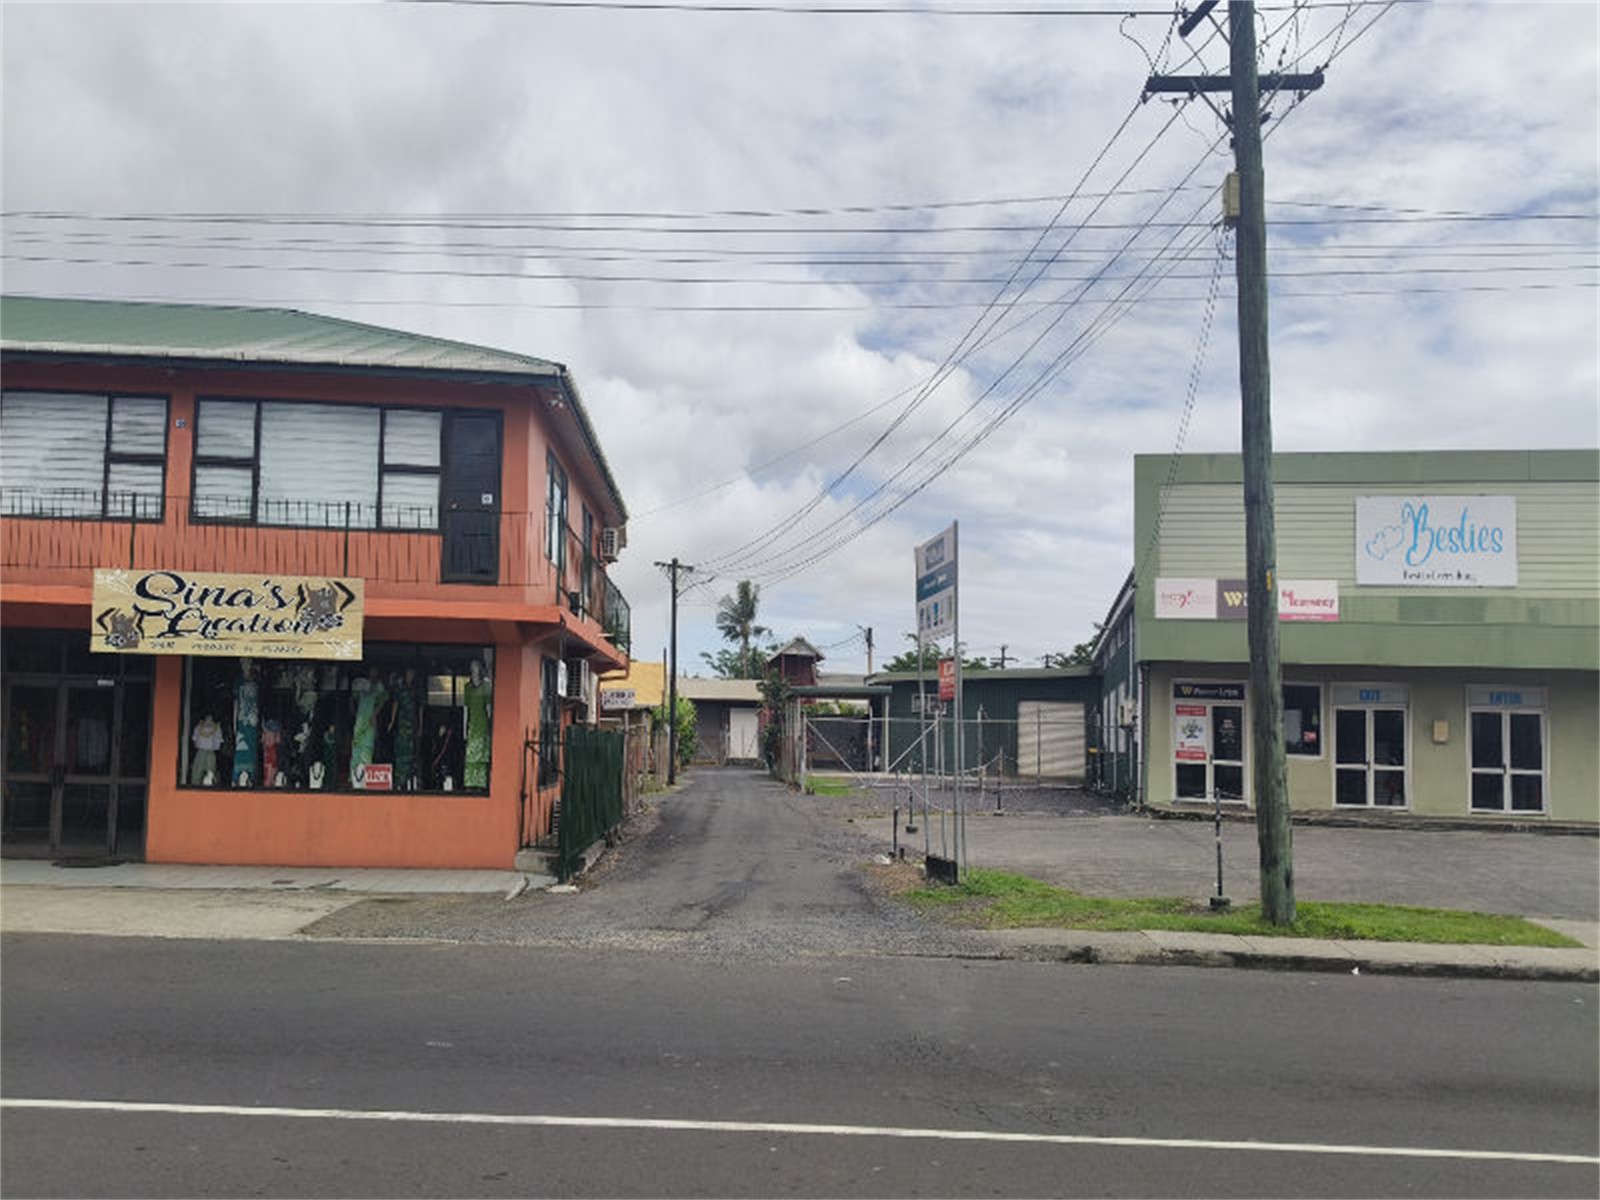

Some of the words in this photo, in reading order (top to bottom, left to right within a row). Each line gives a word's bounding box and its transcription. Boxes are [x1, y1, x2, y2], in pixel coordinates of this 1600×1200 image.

[1401, 502, 1504, 567] Besties
[133, 571, 296, 615] Sina's
[157, 606, 316, 639] Creation
